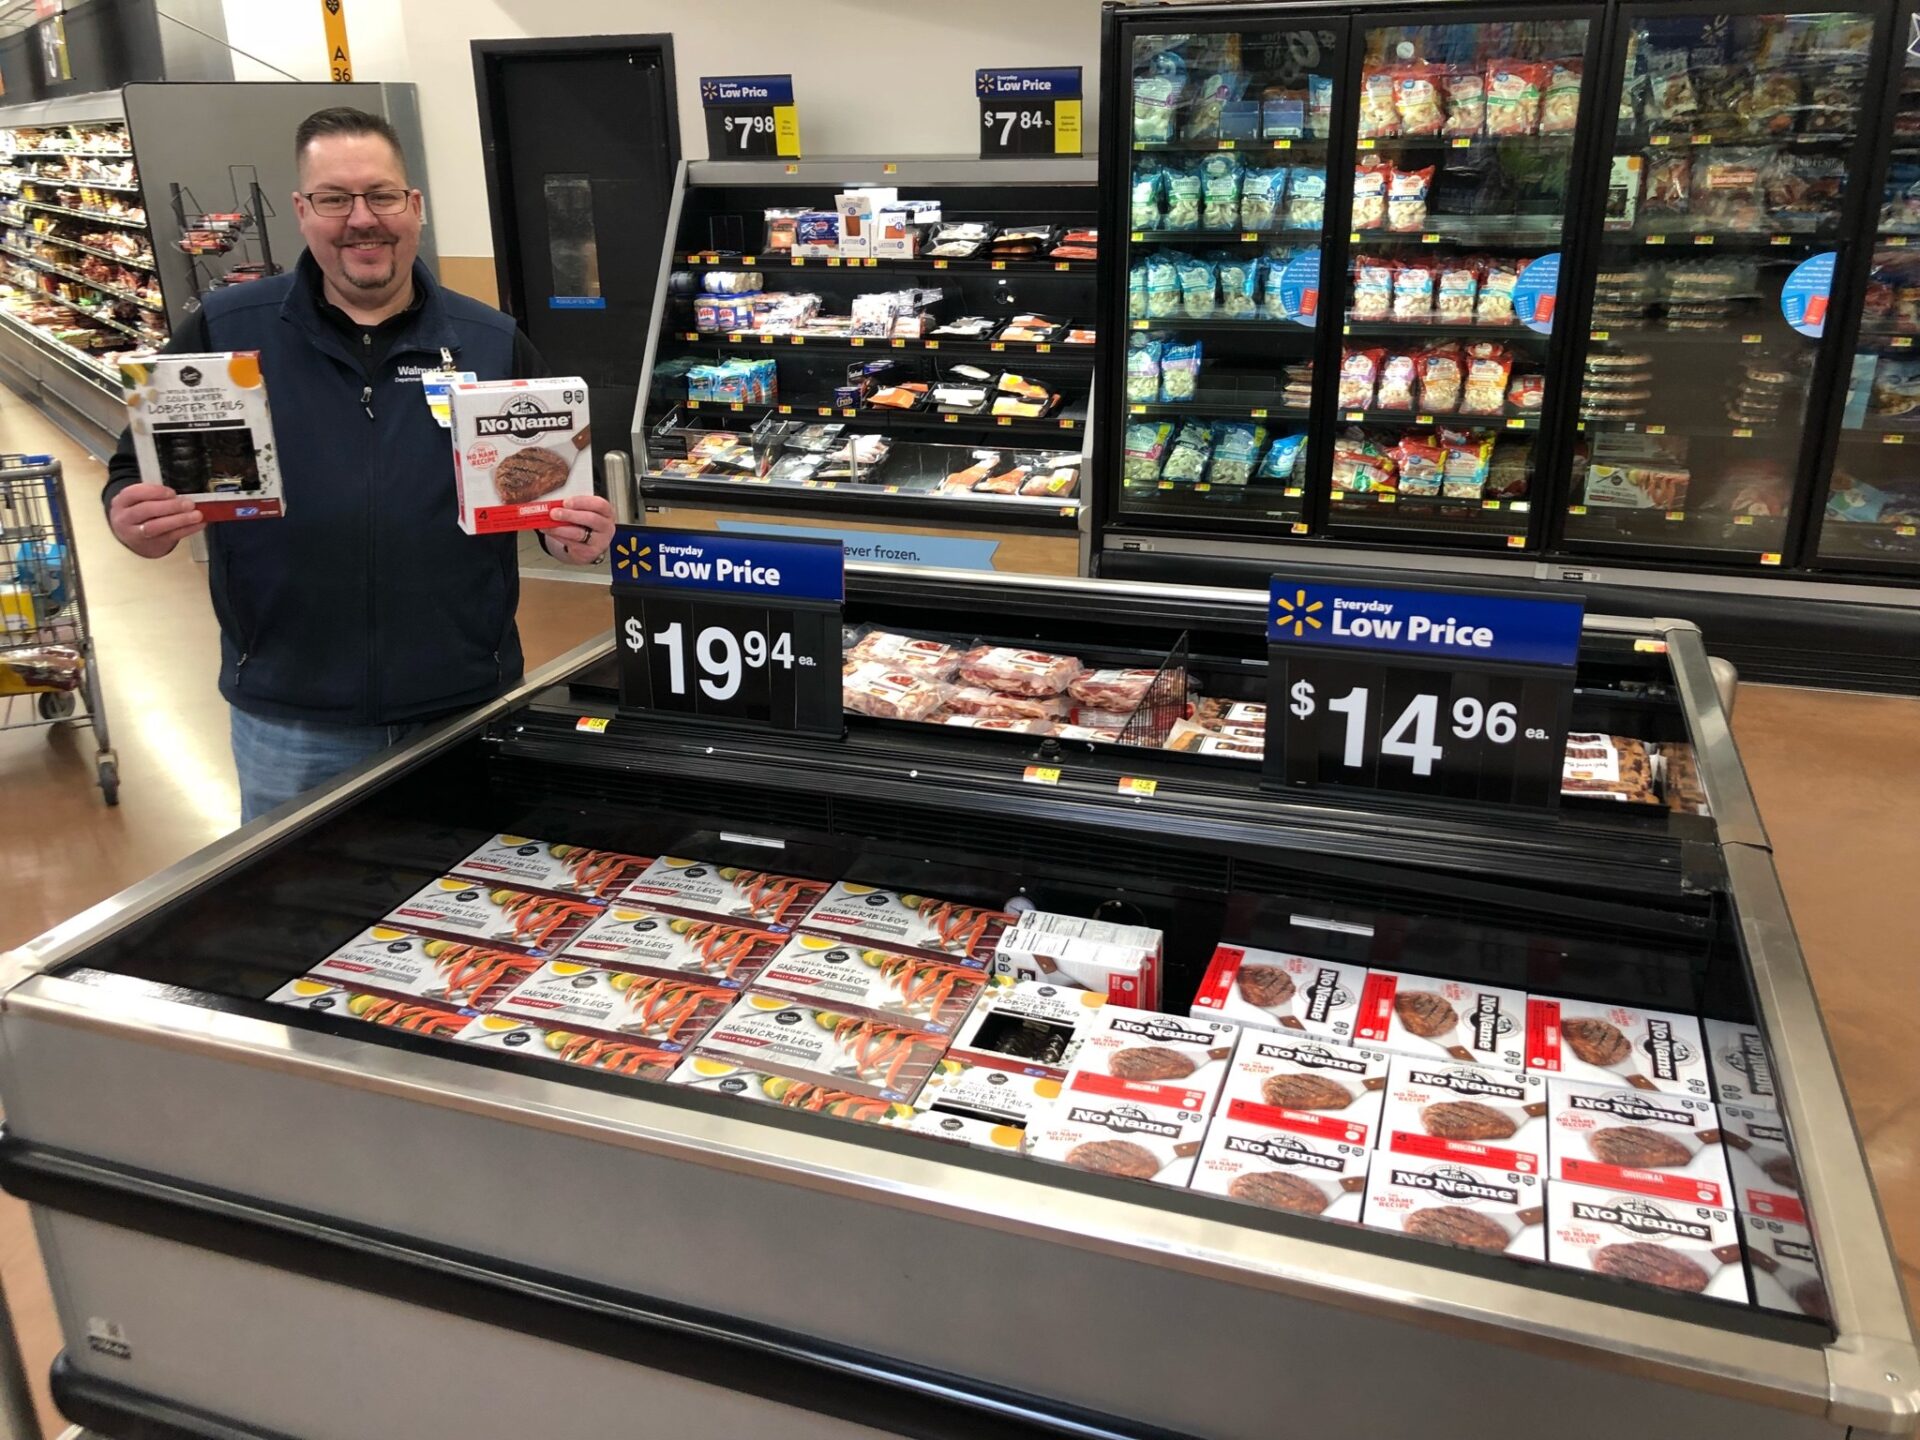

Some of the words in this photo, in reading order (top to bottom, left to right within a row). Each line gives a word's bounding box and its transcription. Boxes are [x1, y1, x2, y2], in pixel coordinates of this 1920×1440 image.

[334, 45, 347, 61] A
[333, 67, 351, 82] 36
[720, 88, 740, 98] Low
[742, 86, 768, 98] Price
[997, 80, 1021, 91] Low
[1022, 79, 1052, 90] Price
[397, 366, 442, 376] Walmart
[148, 402, 208, 415] LOBSTER
[212, 400, 245, 411] TAILS
[479, 420, 508, 434] No
[510, 416, 569, 431] Name
[466, 453, 477, 461] NO
[478, 450, 498, 460] NAME
[472, 457, 496, 466] RECIPE
[478, 510, 488, 520] 4
[658, 544, 704, 558] Everyday
[843, 546, 872, 558] ever
[874, 544, 921, 562] frozen.
[659, 554, 711, 580] Low
[716, 558, 780, 586] Price
[1333, 598, 1393, 614] Everyday
[1332, 610, 1402, 640] Low
[1408, 616, 1494, 648] Price
[822, 906, 850, 914] SNOW
[851, 910, 880, 920] CRAB
[880, 914, 909, 925] LEGS
[588, 934, 616, 942] SNOW
[617, 937, 644, 946] CRAB
[644, 941, 674, 950] LEGS
[776, 963, 808, 974] SNOW
[809, 969, 838, 978] CRAB
[840, 974, 870, 984] LEGS
[520, 990, 552, 998] SNOW
[552, 994, 581, 1004] CRAB
[582, 998, 614, 1009] LEGS
[724, 1024, 757, 1034] SNOW
[758, 1030, 790, 1041] CRAB
[790, 1036, 824, 1048] LEGS
[1114, 1020, 1146, 1032] No
[1146, 1026, 1211, 1042] Name
[1650, 1022, 1669, 1039] No
[1260, 1045, 1294, 1058] No
[1294, 1052, 1363, 1071] Name
[1652, 1039, 1674, 1079] Name
[1414, 1072, 1448, 1085] No
[1450, 1080, 1521, 1096] Name
[1575, 1097, 1611, 1110] No
[1613, 1103, 1690, 1122] Name
[1072, 1110, 1107, 1122] No
[1106, 1114, 1178, 1136] Name
[1228, 1139, 1266, 1152] No
[1266, 1145, 1341, 1168] Name
[1395, 1172, 1432, 1186] No
[1434, 1178, 1514, 1200] Name
[1578, 1204, 1618, 1220] No
[1619, 1212, 1706, 1237] Name
